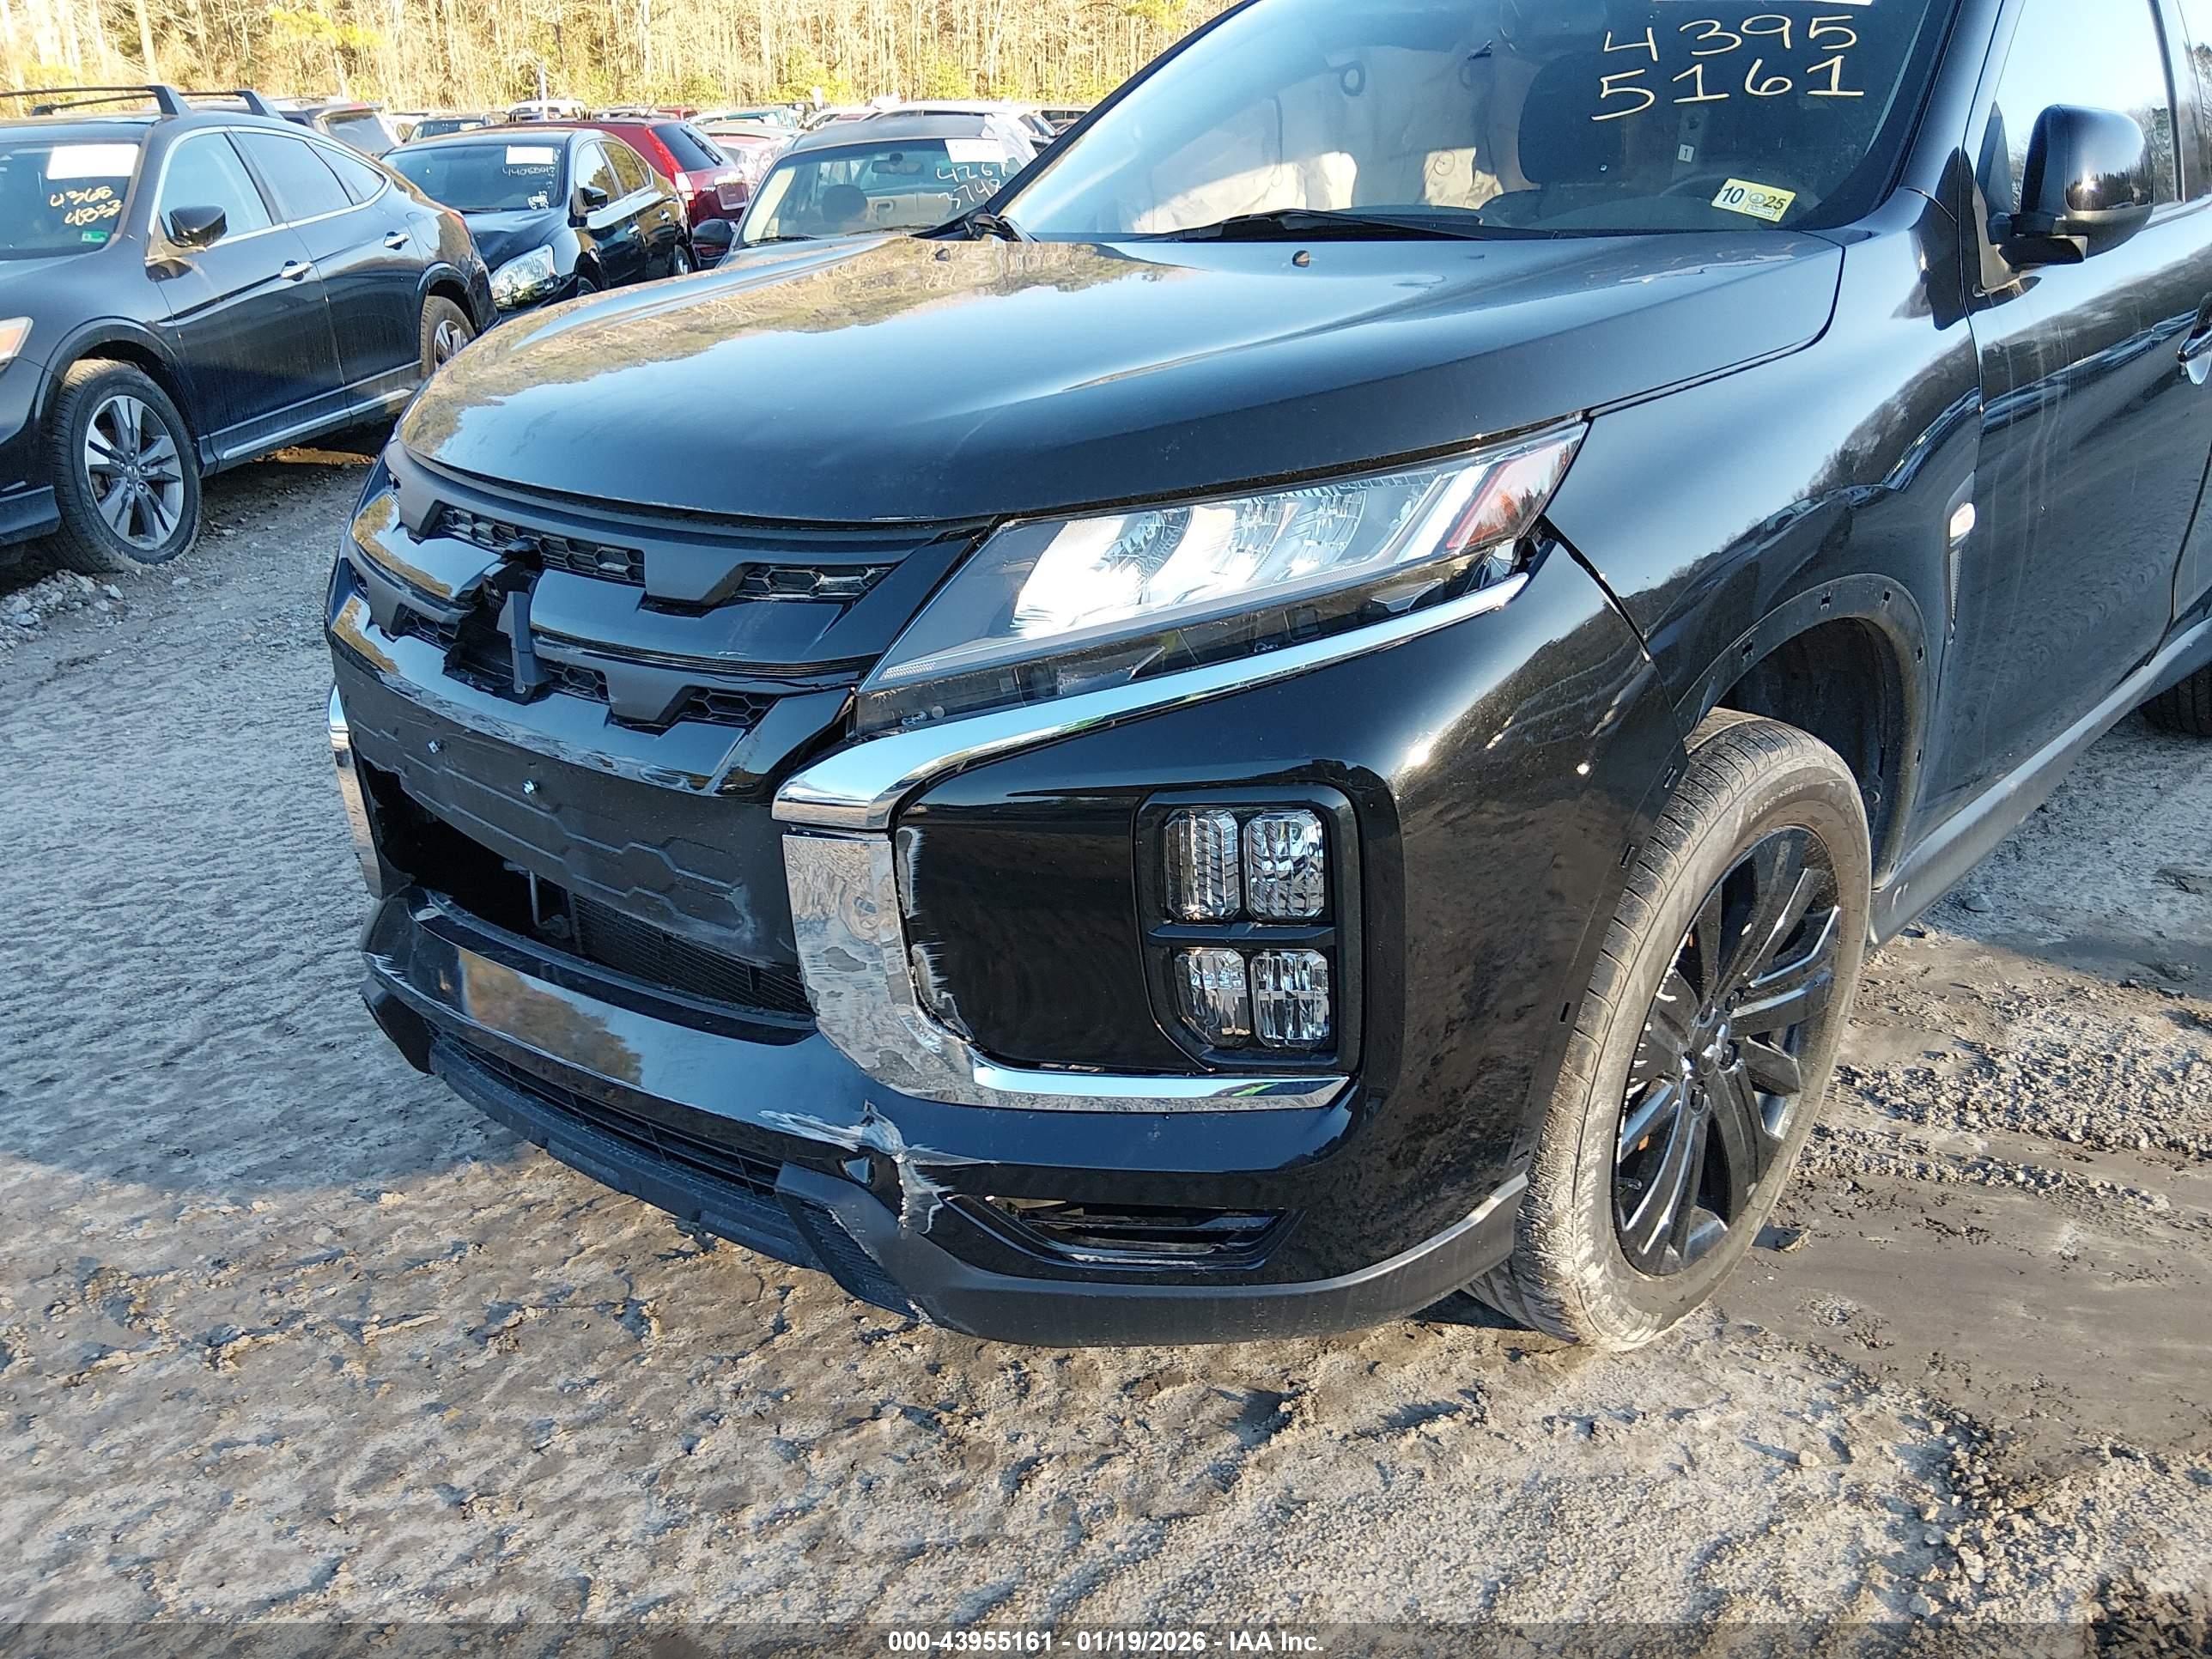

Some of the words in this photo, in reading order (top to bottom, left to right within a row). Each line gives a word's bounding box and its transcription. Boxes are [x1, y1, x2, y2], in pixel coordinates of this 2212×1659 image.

[1603, 14, 1857, 62] 4395
[1590, 54, 1865, 121] 5161
[1722, 185, 1746, 204] 10
[1763, 195, 1787, 210] 25
